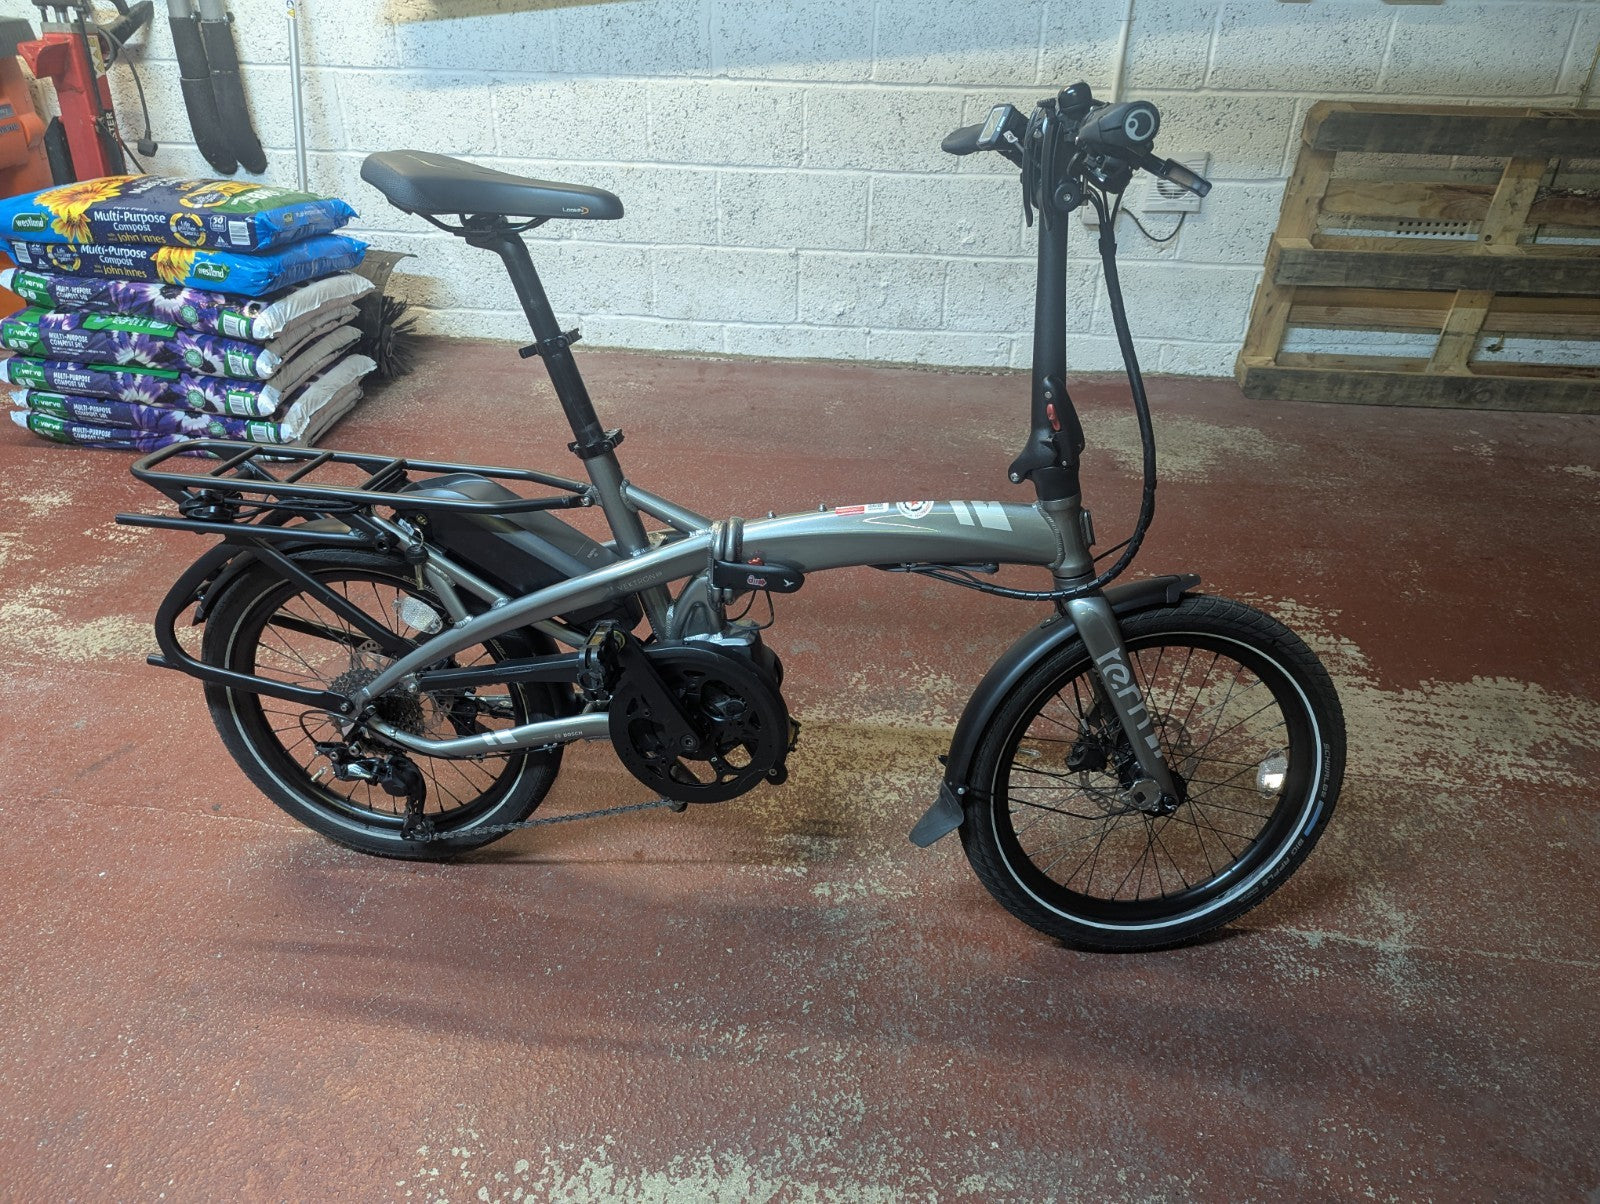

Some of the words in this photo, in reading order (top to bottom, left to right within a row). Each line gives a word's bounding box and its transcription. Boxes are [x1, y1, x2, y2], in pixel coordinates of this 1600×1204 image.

[94, 210, 166, 225] Multi-Purpose
[212, 216, 224, 225] 50
[113, 222, 151, 232] Compost
[117, 232, 140, 242] John
[141, 234, 167, 244] Innes
[80, 244, 147, 260] Multi-Purpose
[99, 255, 134, 266] Compost
[103, 265, 124, 275] John
[124, 267, 148, 278] Innes
[24, 280, 44, 289] verve
[15, 329, 38, 338] verve
[22, 368, 42, 377] verve
[40, 400, 61, 408] verve
[40, 421, 60, 430] verve
[563, 730, 583, 738] BOSCH
[1321, 742, 1331, 799] SCHWALBE
[1291, 838, 1305, 856] BIG
